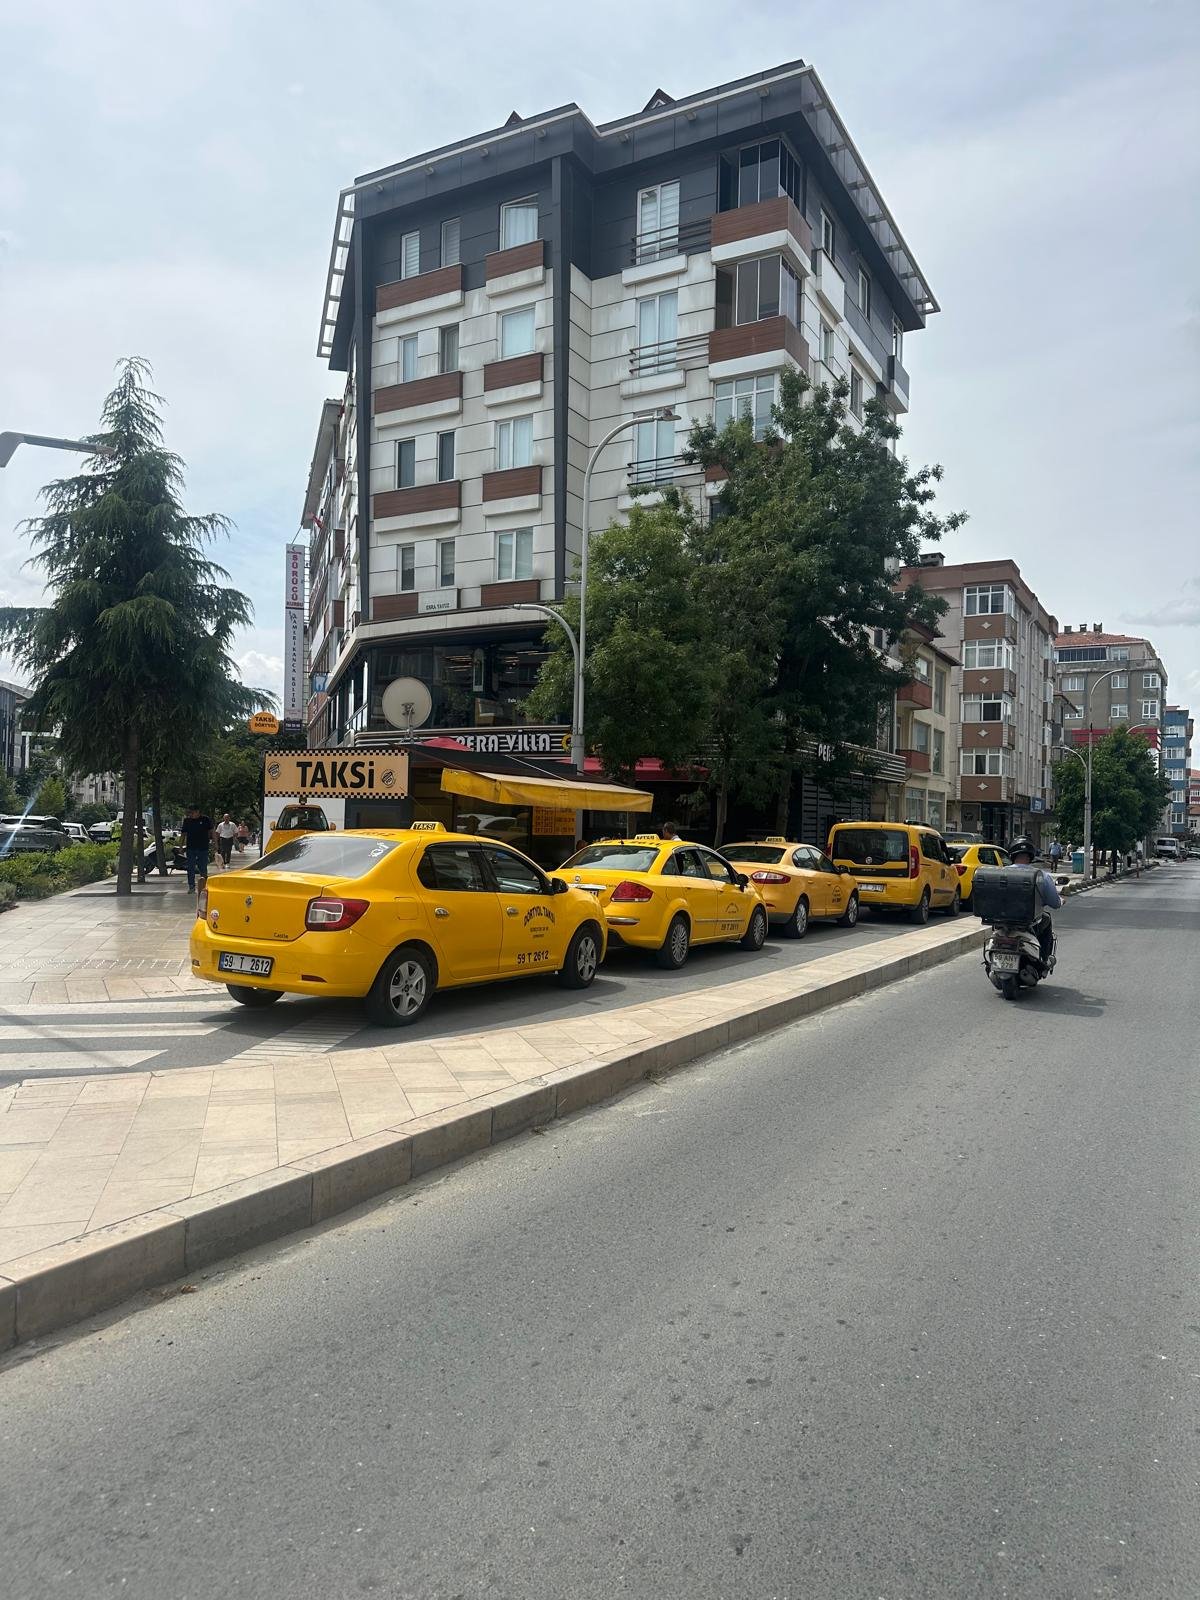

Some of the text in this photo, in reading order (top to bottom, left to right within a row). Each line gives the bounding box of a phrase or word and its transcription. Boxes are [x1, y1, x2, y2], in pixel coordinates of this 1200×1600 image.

[291, 554, 299, 601] SÜRÜCÜ
[224, 955, 234, 968] 59
[239, 956, 245, 969] T
[250, 958, 270, 973] 2612
[517, 950, 549, 965] 59 T 2612
